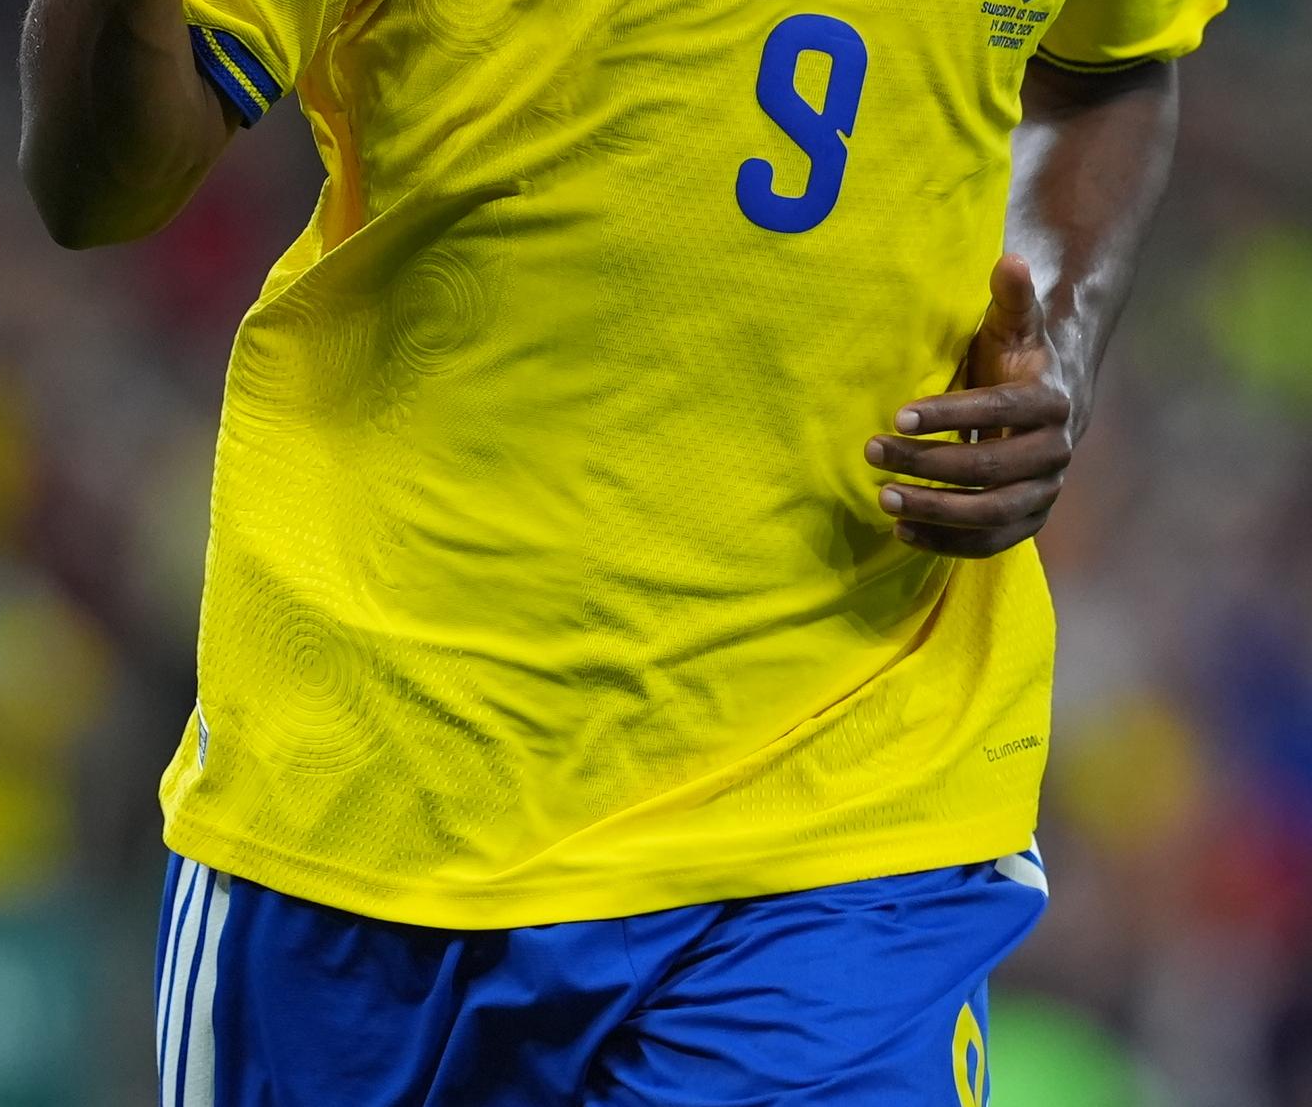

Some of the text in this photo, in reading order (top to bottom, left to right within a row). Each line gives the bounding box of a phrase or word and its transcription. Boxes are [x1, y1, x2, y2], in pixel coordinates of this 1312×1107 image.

[981, 1, 1016, 18] SWEDEN
[998, 20, 1017, 34] JUNE
[736, 13, 868, 233] 9
